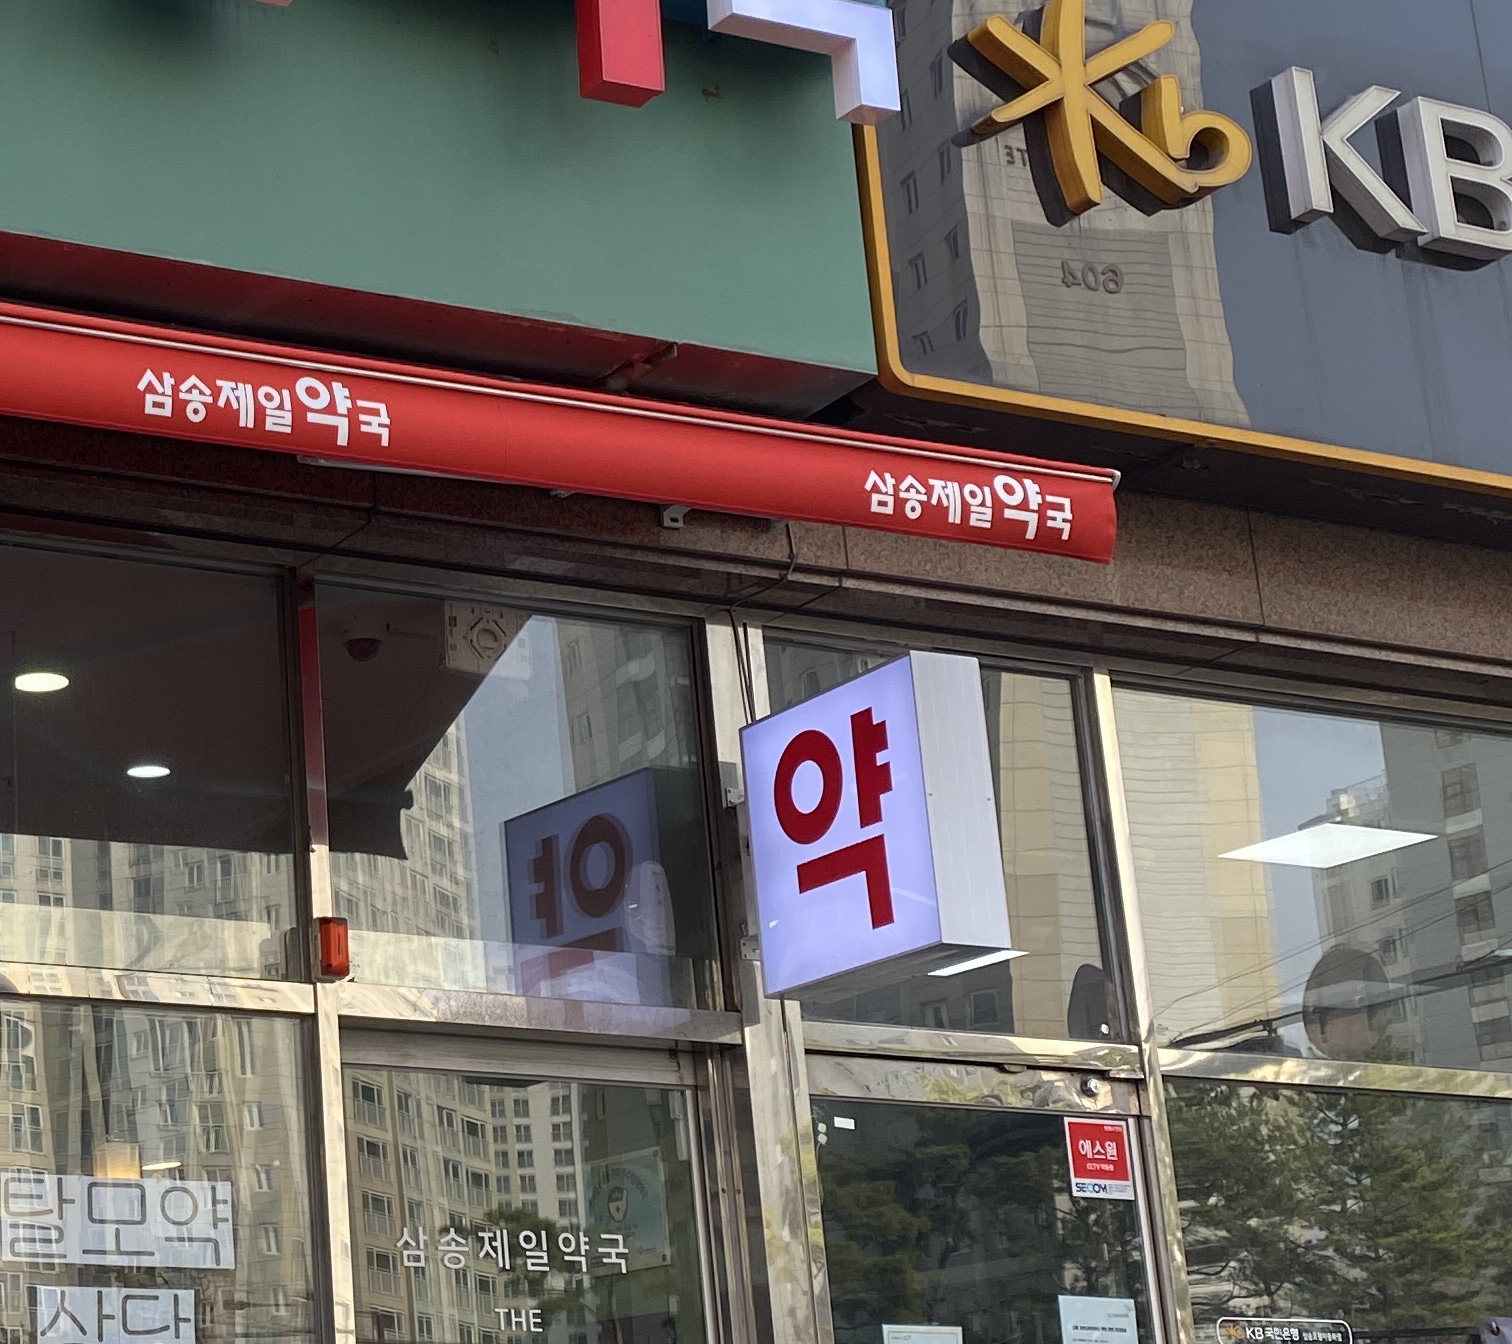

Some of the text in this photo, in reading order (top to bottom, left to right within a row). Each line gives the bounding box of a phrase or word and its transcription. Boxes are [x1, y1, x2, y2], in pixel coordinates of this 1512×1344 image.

[135, 366, 391, 448] 삼송제일약국
[863, 470, 1075, 543] 삼송제일약국
[773, 706, 895, 931] 약
[1078, 1139, 1119, 1161] 에스원
[1075, 1182, 1109, 1194] SECOM
[2, 1176, 230, 1267] 탈모약
[395, 1225, 630, 1274] 삼송제일약국
[494, 1308, 544, 1333] THE
